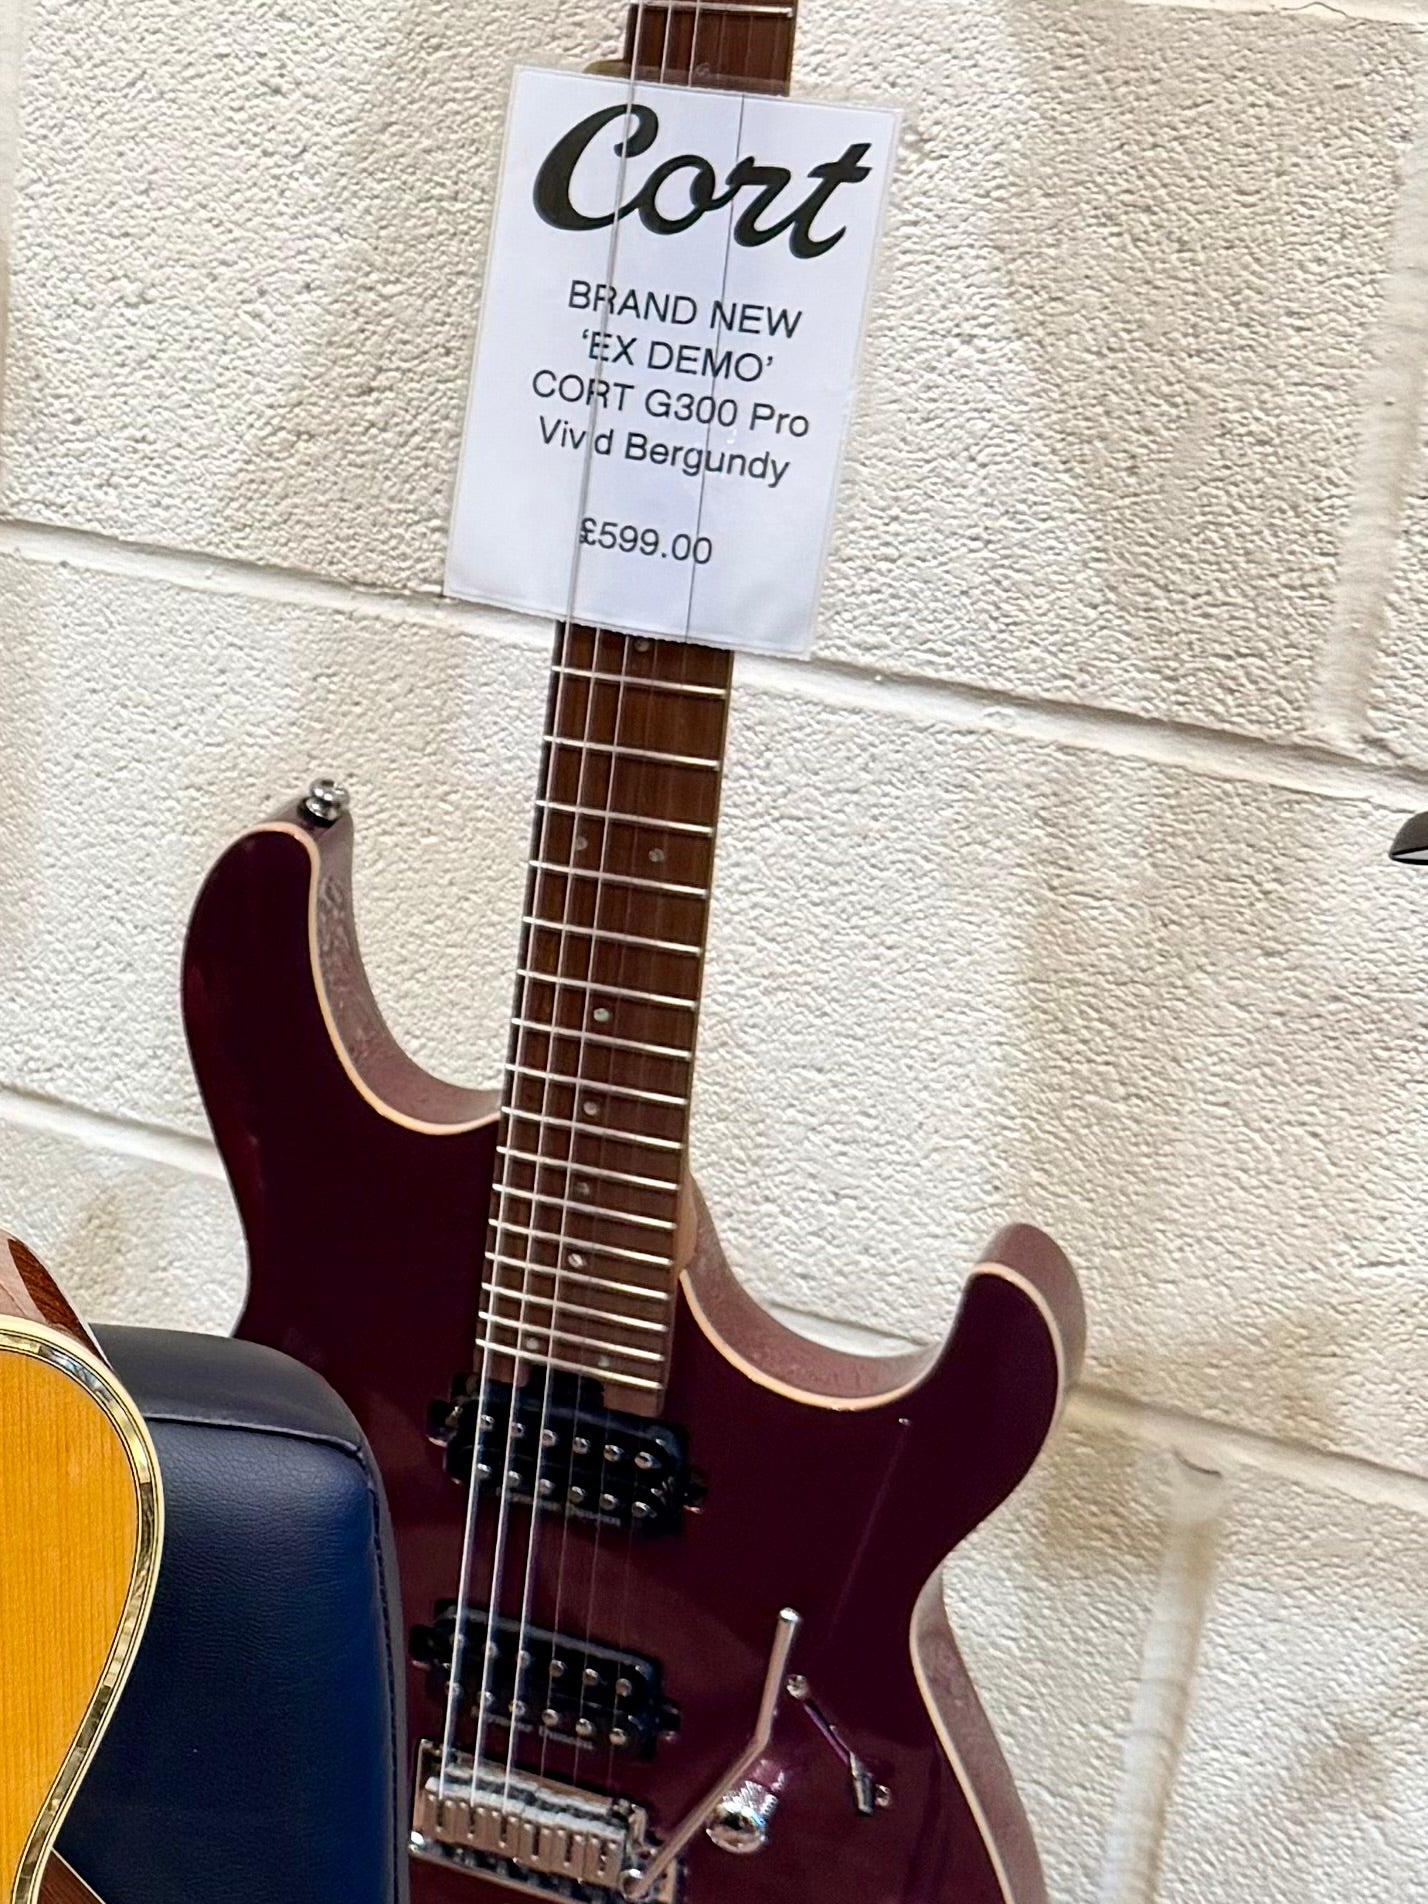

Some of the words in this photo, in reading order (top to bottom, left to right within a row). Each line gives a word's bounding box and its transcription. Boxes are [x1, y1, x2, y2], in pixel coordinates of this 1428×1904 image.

[532, 103, 874, 259] Cort
[568, 278, 697, 326] BRAND
[710, 299, 802, 339] NEW
[532, 369, 634, 413] CORT
[644, 391, 738, 428] G300
[749, 403, 810, 438] Pro
[624, 432, 790, 489] Bergundy
[578, 517, 714, 565] £599.00
